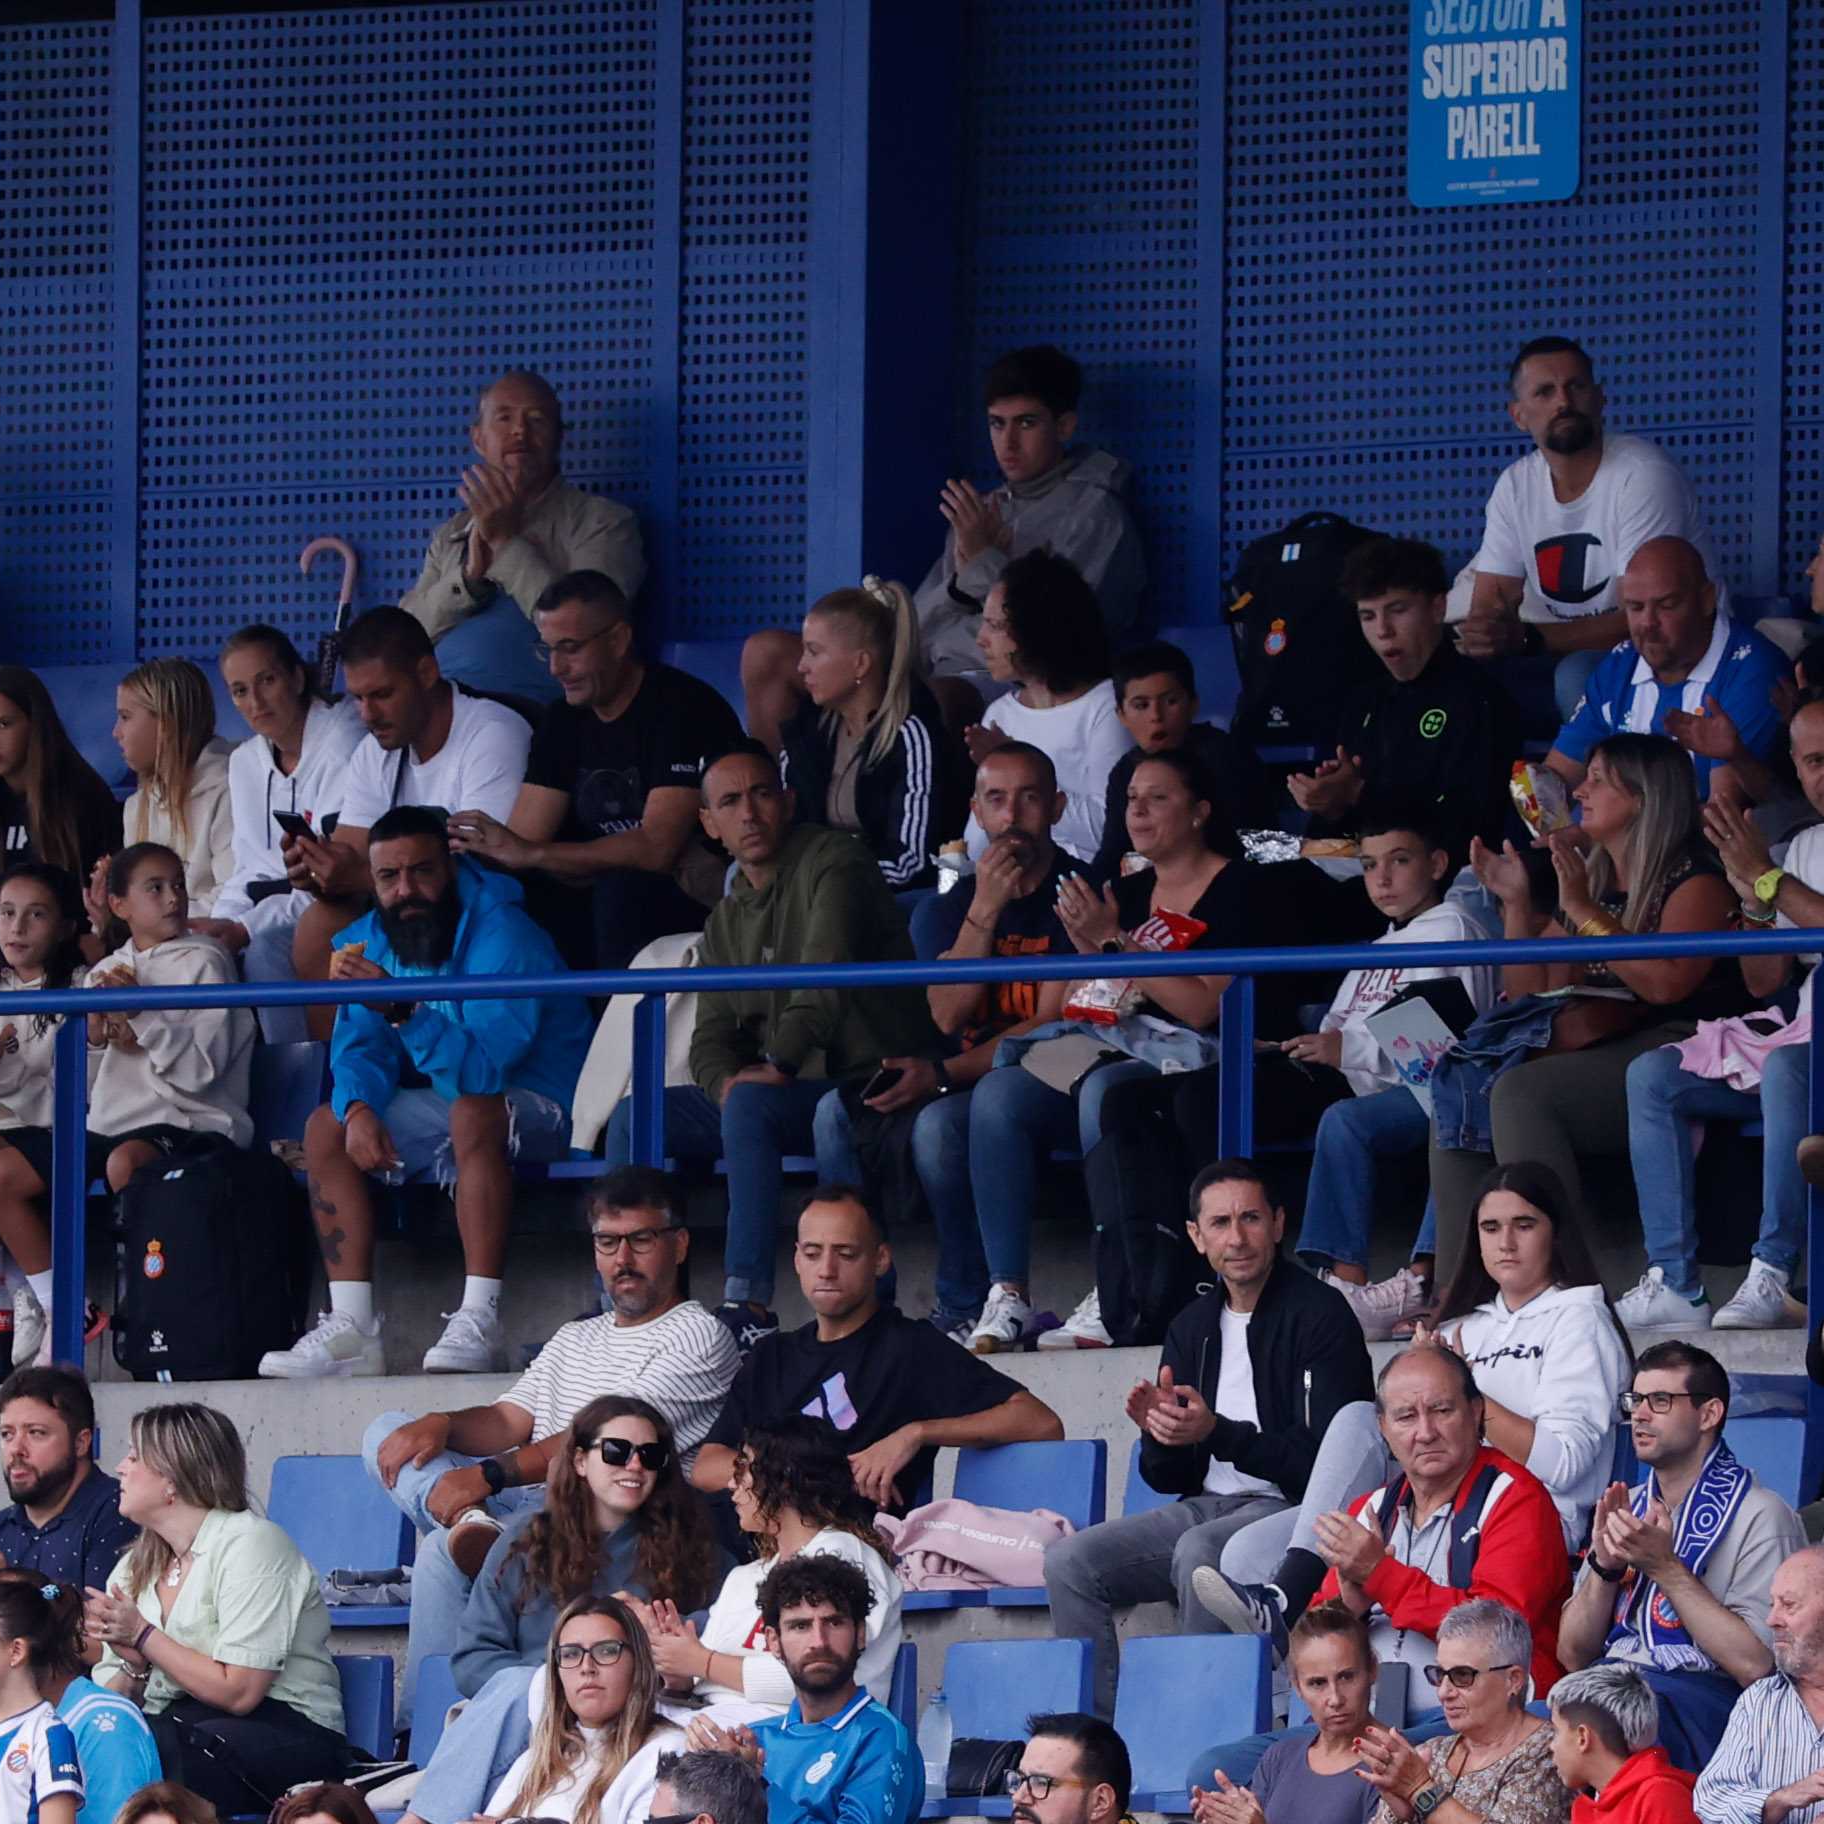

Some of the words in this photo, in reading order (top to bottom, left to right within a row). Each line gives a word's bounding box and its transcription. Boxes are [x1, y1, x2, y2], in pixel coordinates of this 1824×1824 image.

[1539, 0, 1567, 29] A
[1422, 37, 1567, 100] SUPERIOR
[1446, 101, 1541, 160] PARELL
